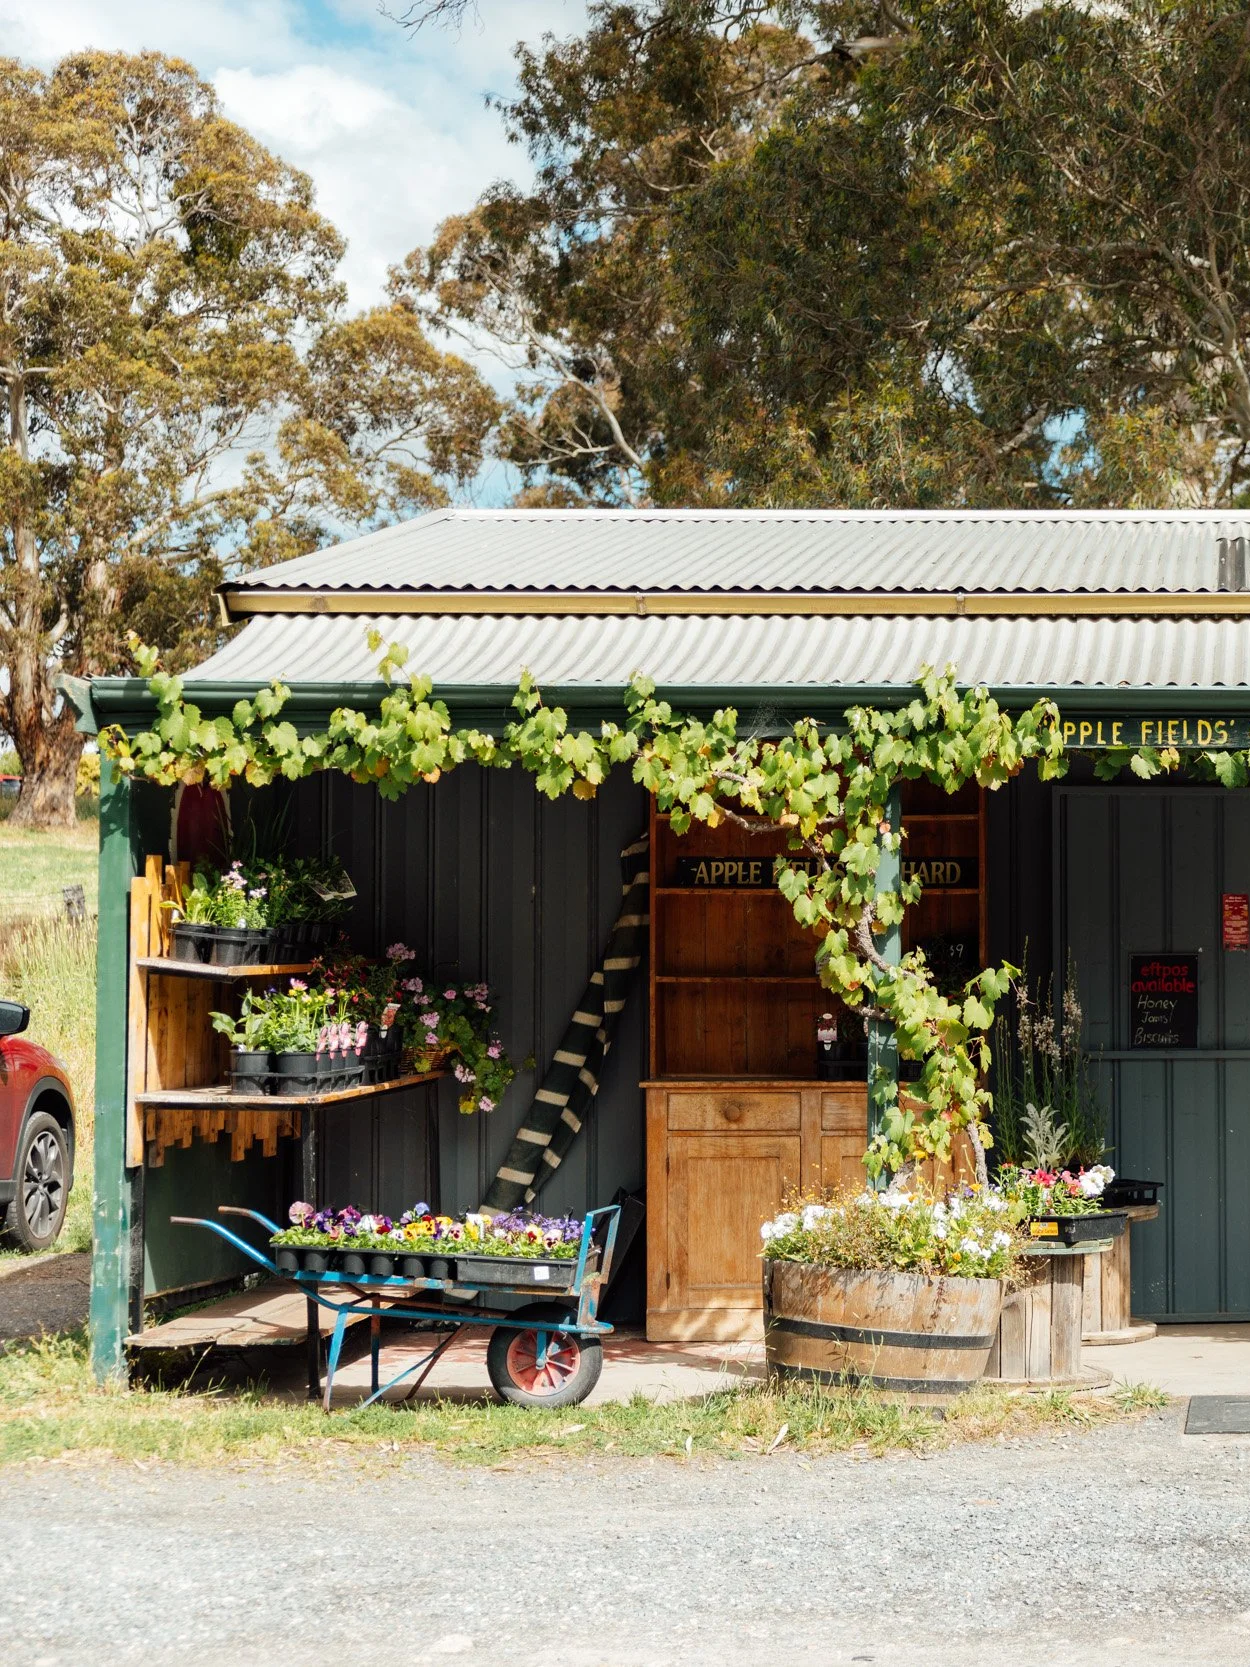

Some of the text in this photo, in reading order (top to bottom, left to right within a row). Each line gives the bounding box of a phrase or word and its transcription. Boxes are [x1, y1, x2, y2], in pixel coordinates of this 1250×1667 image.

[695, 861, 762, 884] APPLE
[1141, 962, 1189, 979] eftpos
[1131, 977, 1196, 993] available
[1137, 995, 1178, 1018] Honey
[1134, 1027, 1181, 1045] Biscuits
